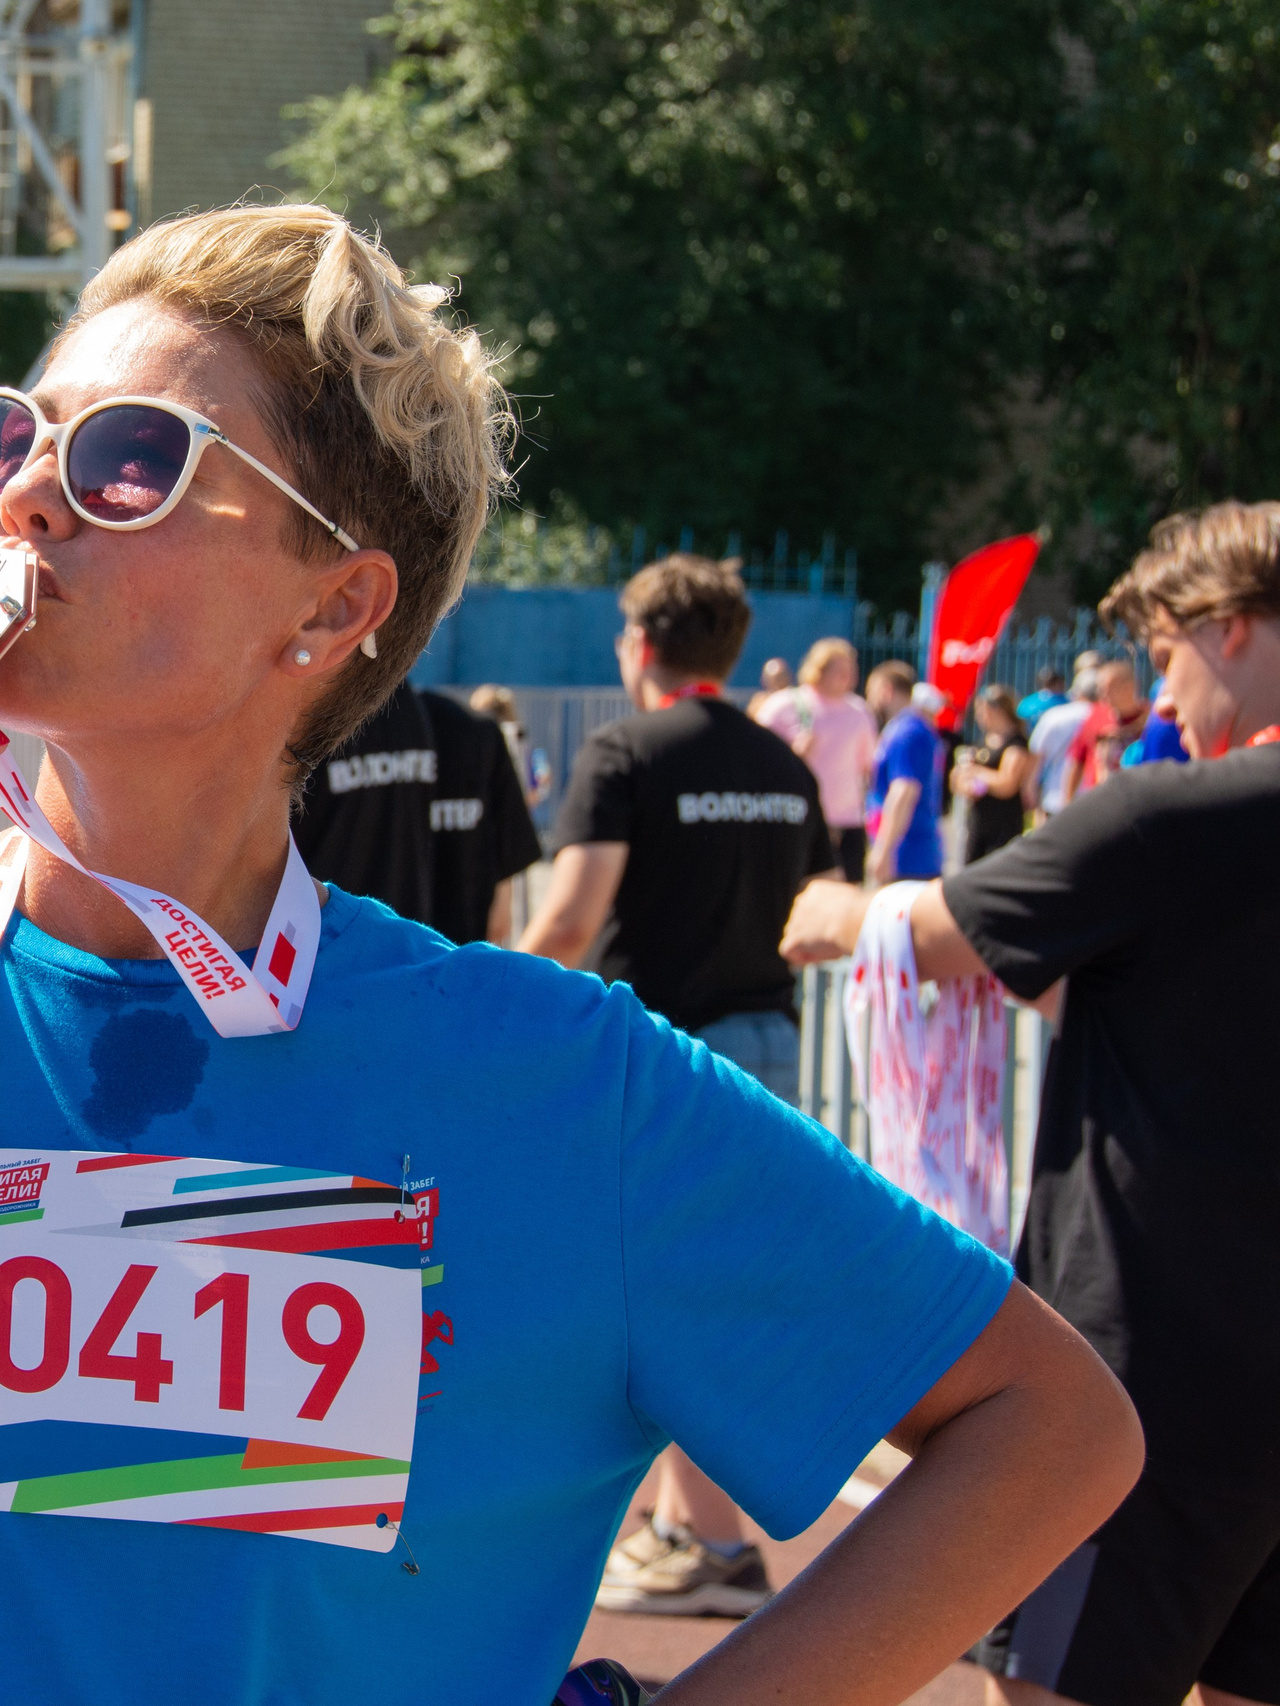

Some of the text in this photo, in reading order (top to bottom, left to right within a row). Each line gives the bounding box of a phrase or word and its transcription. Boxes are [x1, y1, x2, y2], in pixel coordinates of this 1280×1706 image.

[150, 899, 247, 992] ДОСТИГАЯ
[165, 931, 226, 1000] ЦЕЛИ!
[22, 1158, 42, 1167] ЗАБЕГ
[410, 1176, 435, 1191] ЗАБЕГ
